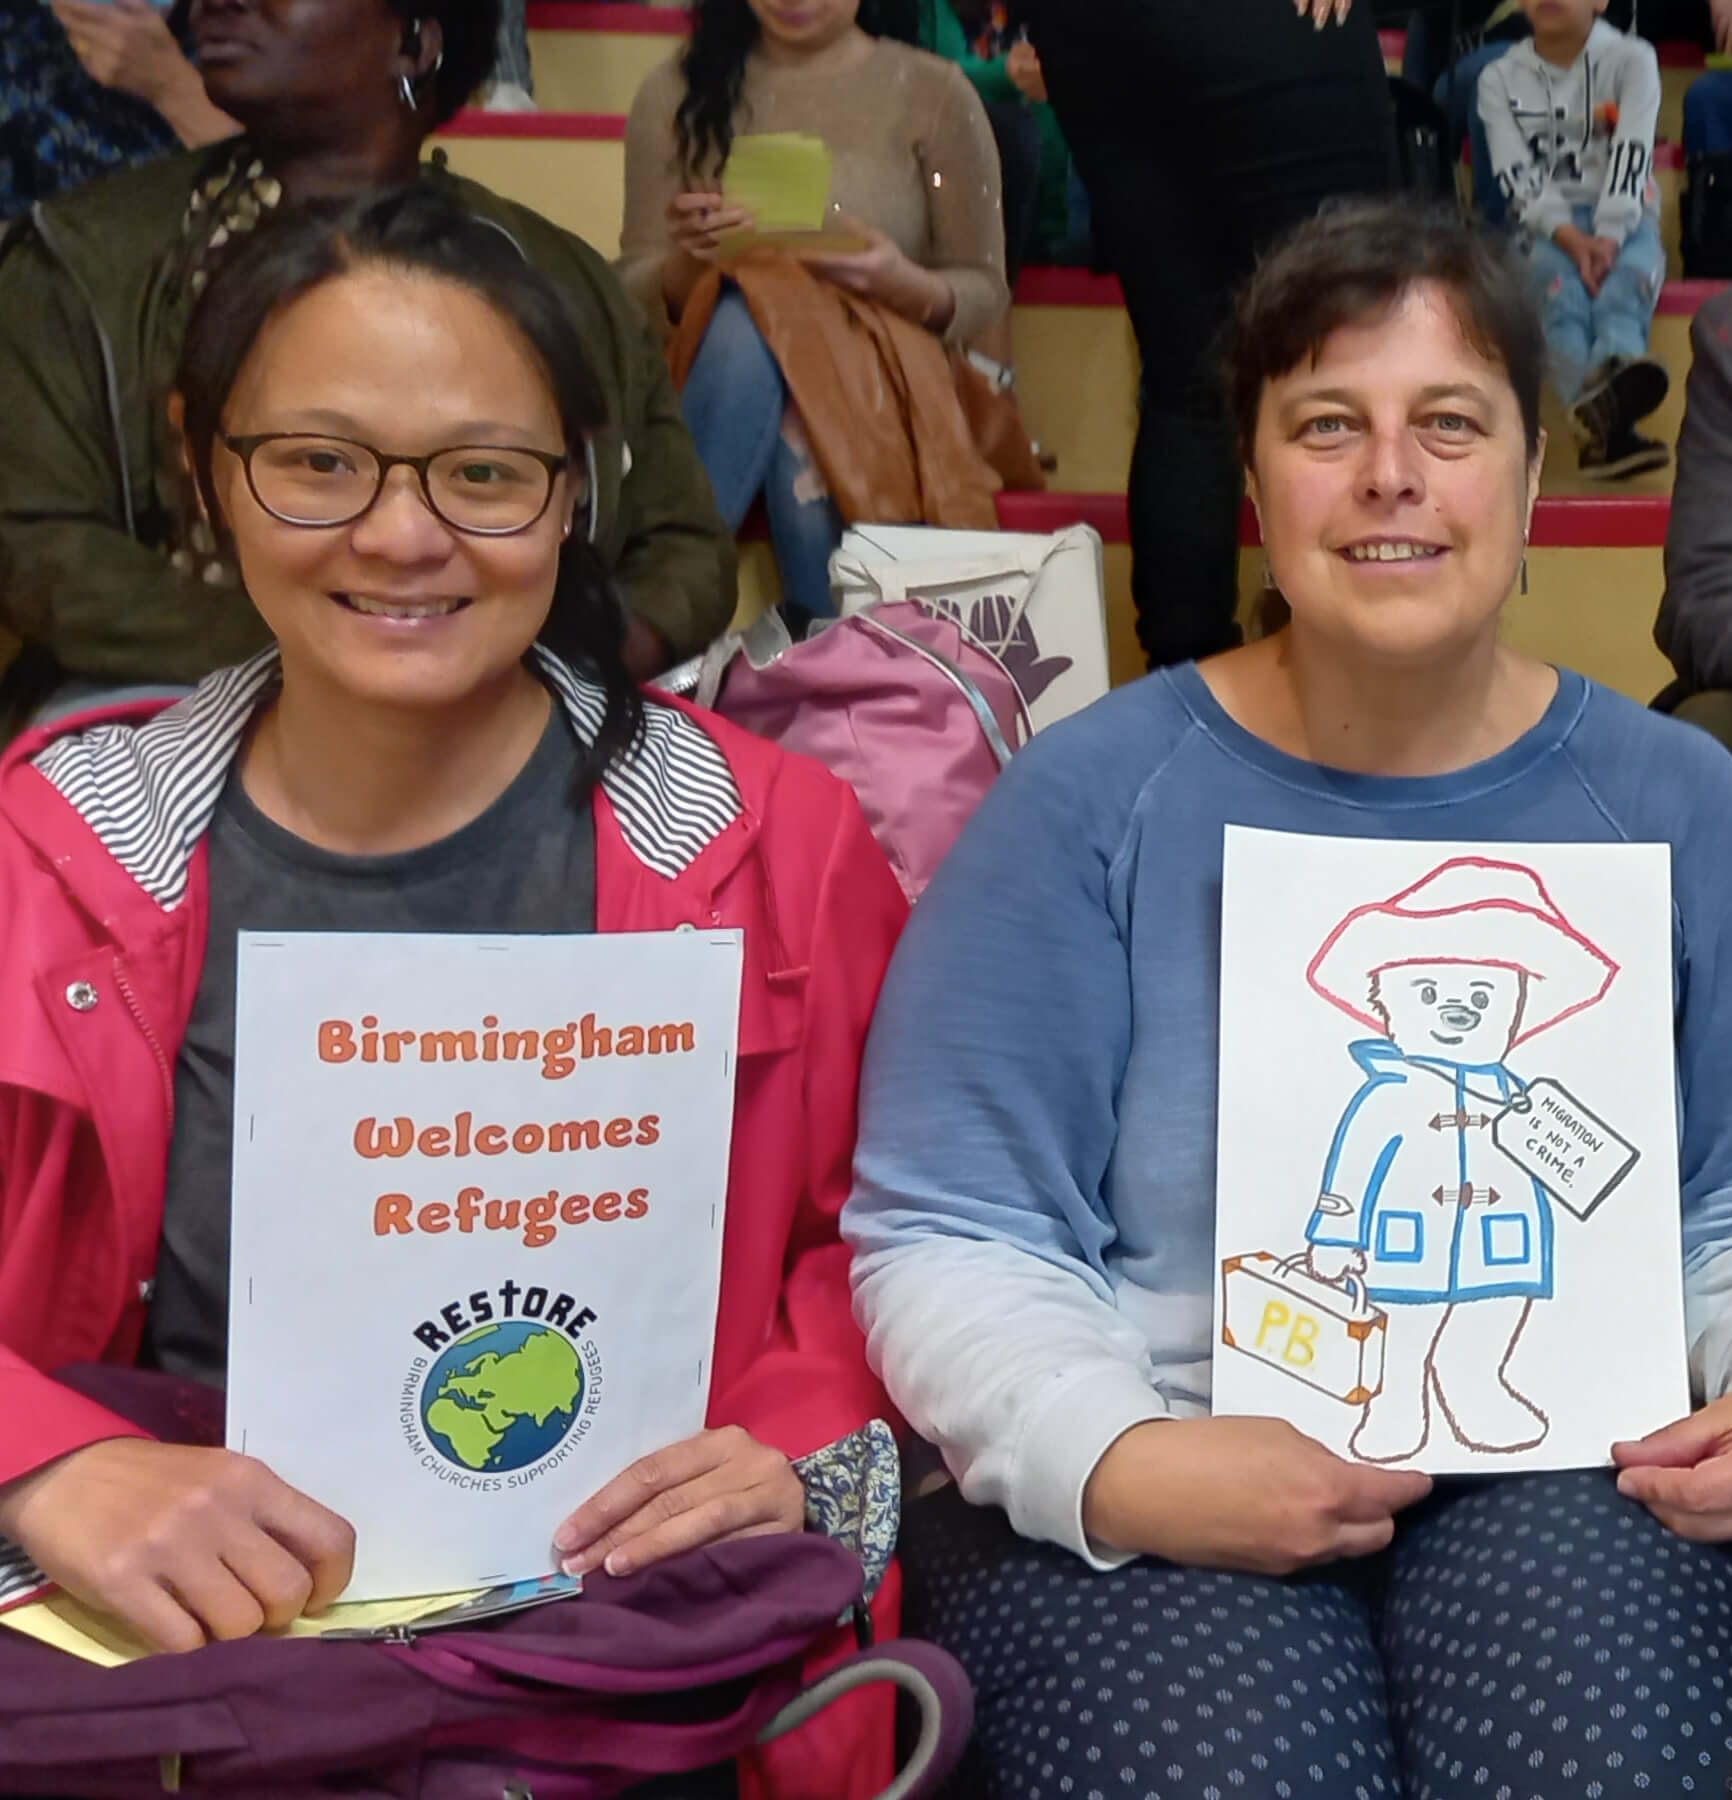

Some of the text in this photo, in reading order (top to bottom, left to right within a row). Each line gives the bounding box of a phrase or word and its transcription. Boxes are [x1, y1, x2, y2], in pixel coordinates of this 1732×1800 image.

[318, 1014, 695, 1079] Birmingham
[354, 1111, 660, 1158] Welcomes
[1529, 1116, 1585, 1168] IS NOT A
[1541, 1096, 1604, 1153] MIGRATION
[374, 1187, 649, 1248] Refugees
[412, 1279, 598, 1352] RESTORE
[400, 1340, 604, 1492] BIRMINGHAM CHURCHES SUPPORTING REFUGEES
